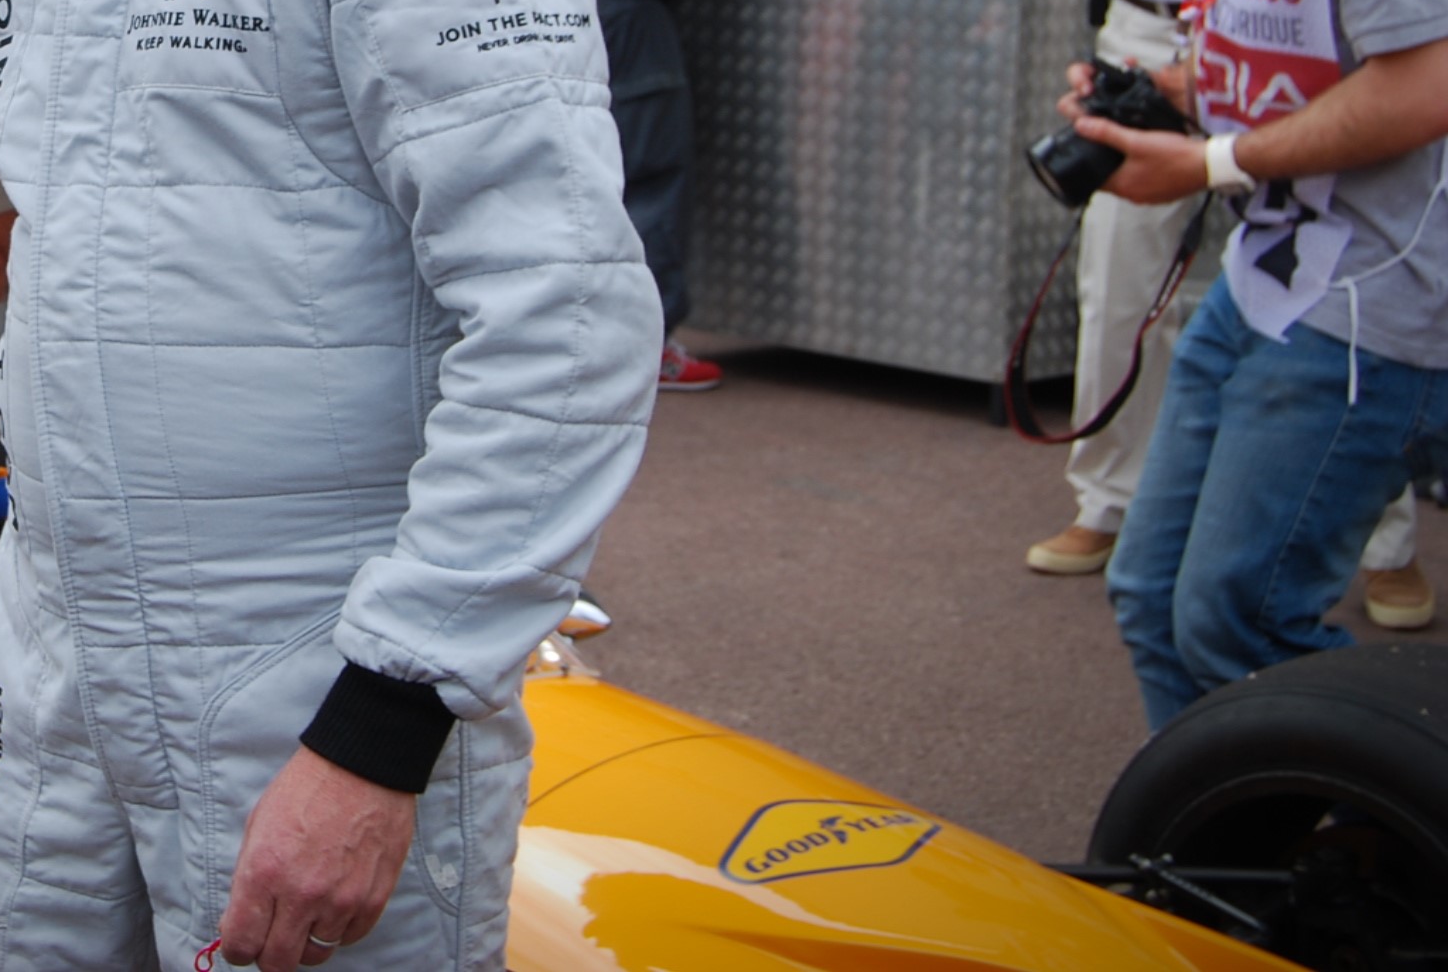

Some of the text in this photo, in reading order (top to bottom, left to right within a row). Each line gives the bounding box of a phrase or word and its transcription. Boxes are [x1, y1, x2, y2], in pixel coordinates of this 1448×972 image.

[127, 11, 185, 34] JOHNNIE
[436, 22, 481, 46] JOIN
[487, 13, 528, 31] THE
[136, 36, 163, 50] KEEP
